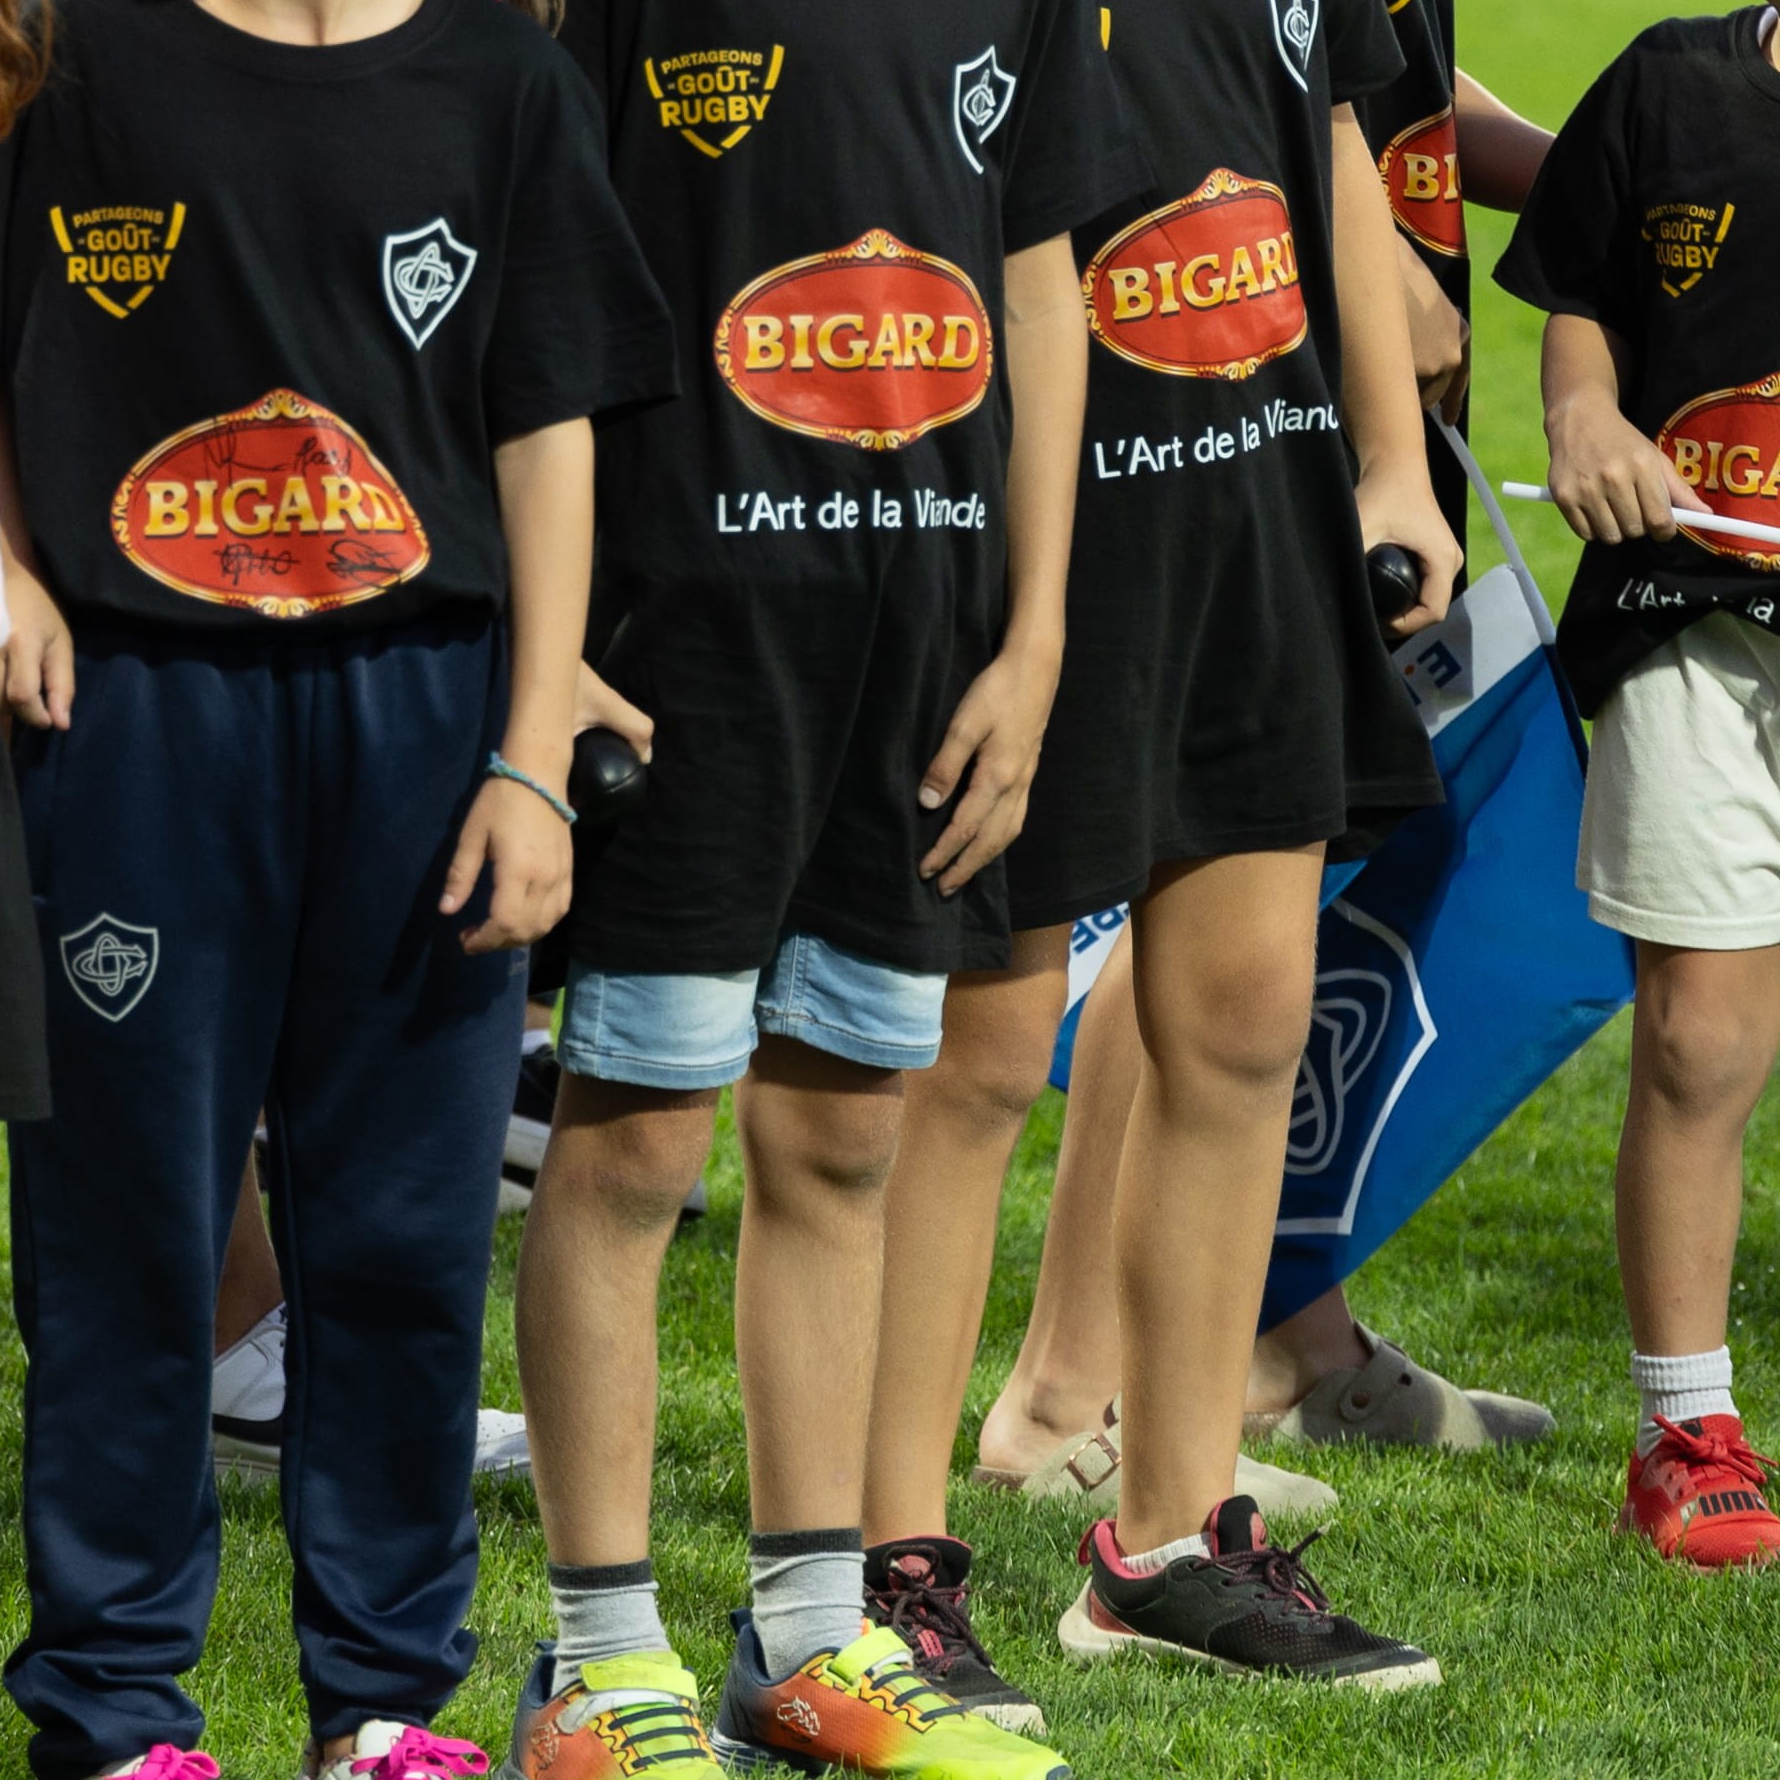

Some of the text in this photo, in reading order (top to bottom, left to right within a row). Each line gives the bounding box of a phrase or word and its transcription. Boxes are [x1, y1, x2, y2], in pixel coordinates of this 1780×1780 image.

[661, 50, 763, 75] PARTAGEONS
[660, 94, 771, 128] RUGBY
[72, 206, 164, 228] PARTAGEONS
[67, 253, 171, 284] RUGBY
[743, 313, 981, 370] BIGARD
[1094, 436, 1183, 480] L'Art
[1193, 426, 1236, 463] de
[1241, 417, 1261, 453] la
[144, 474, 406, 537] BIGARD
[716, 486, 986, 534] L'Art de la Viande
